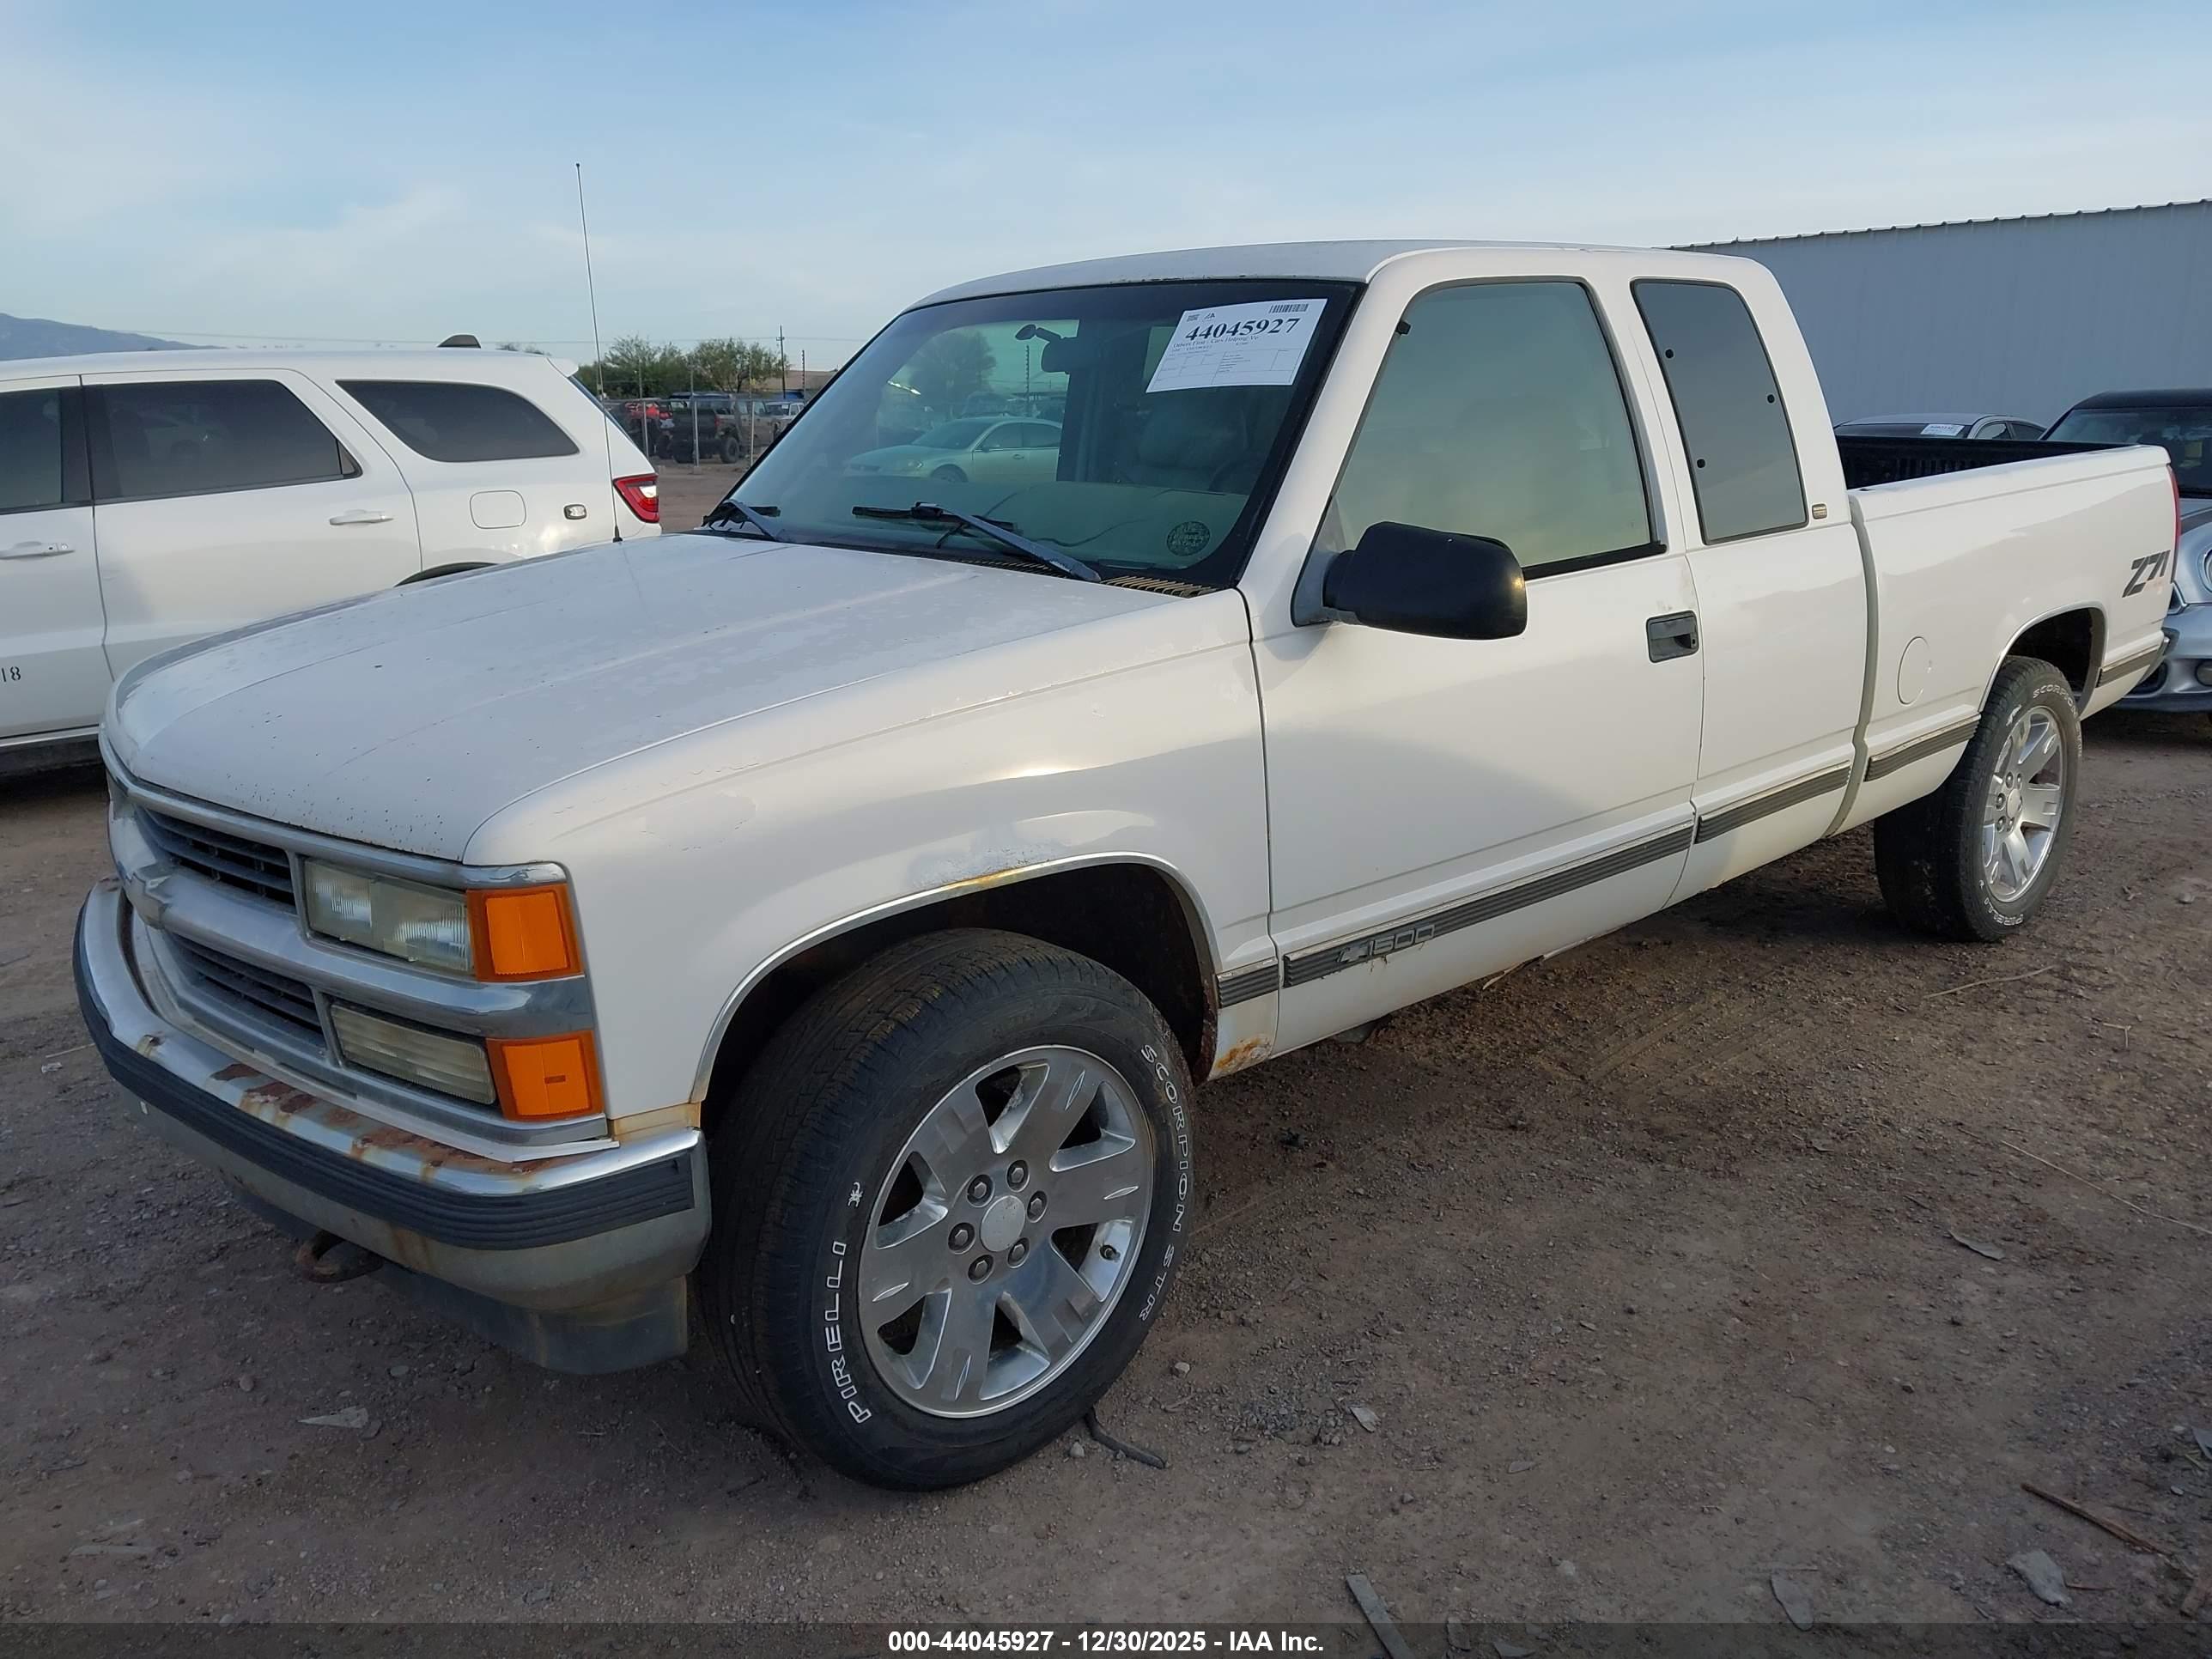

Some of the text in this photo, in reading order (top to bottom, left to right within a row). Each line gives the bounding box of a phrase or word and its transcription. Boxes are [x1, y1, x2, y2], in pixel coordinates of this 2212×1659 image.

[1185, 318, 1301, 341] 44045927
[2122, 550, 2171, 598] Z71
[1984, 896, 2024, 926] PIRELLI
[1369, 924, 1436, 956] 1500
[1138, 1042, 1188, 1322] SCORPION STR
[824, 1240, 872, 1425] PIRELLI
